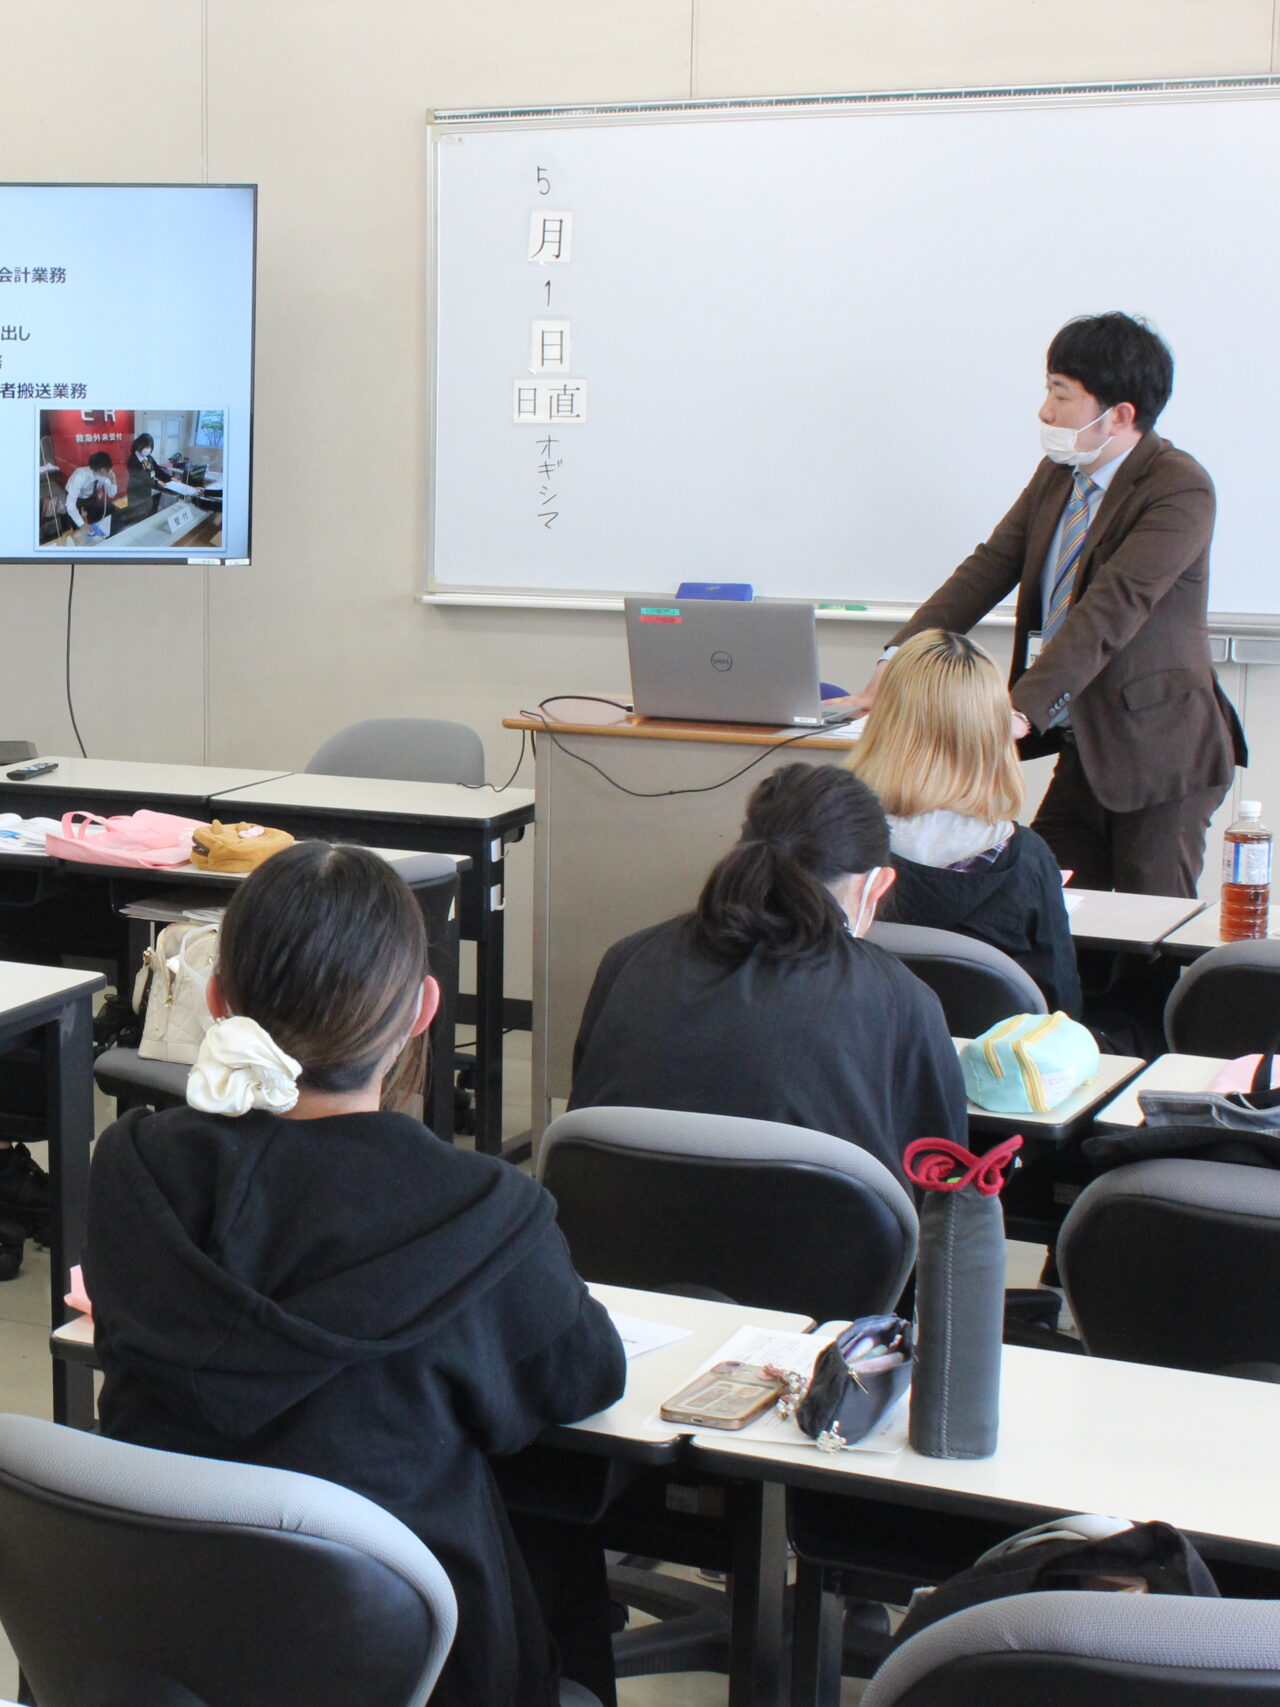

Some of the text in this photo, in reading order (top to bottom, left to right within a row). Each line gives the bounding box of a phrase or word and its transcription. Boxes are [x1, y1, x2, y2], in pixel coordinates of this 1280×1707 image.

[75, 433, 123, 443] 救急外来受付
[536, 435, 562, 529] オギシマ
